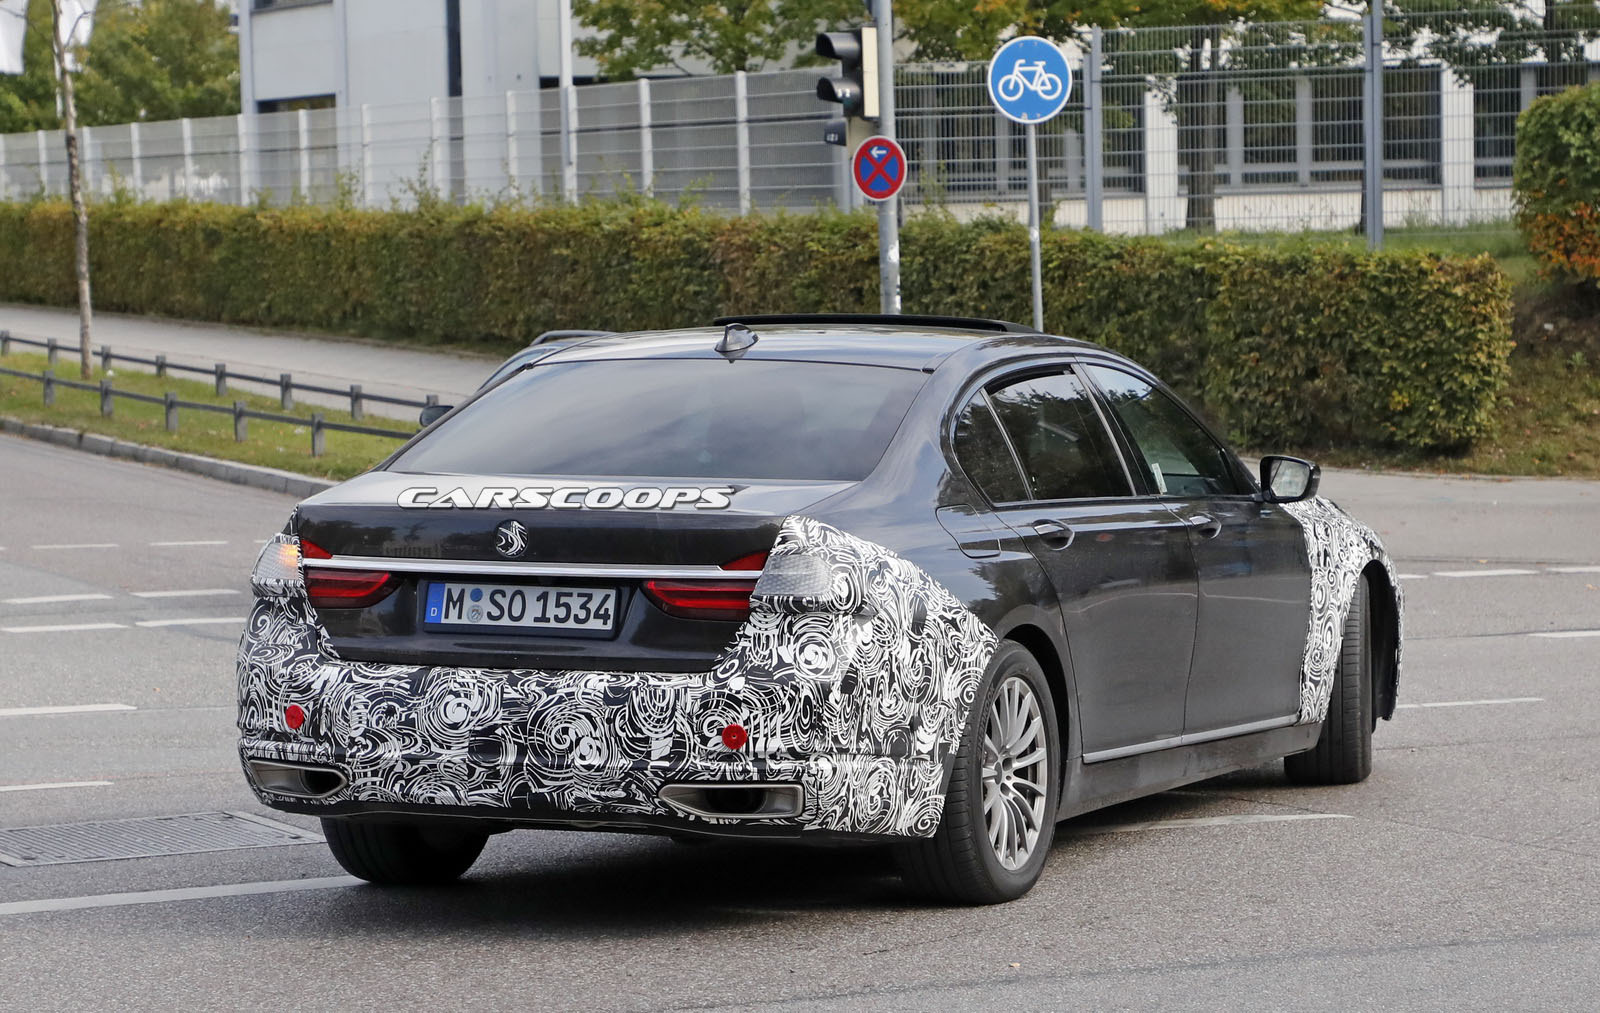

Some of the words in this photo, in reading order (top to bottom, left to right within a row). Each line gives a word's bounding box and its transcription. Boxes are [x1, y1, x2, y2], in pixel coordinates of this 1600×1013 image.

[429, 607, 438, 617] D
[444, 584, 466, 620] M
[486, 589, 527, 622] SO
[533, 591, 612, 626] 1534
